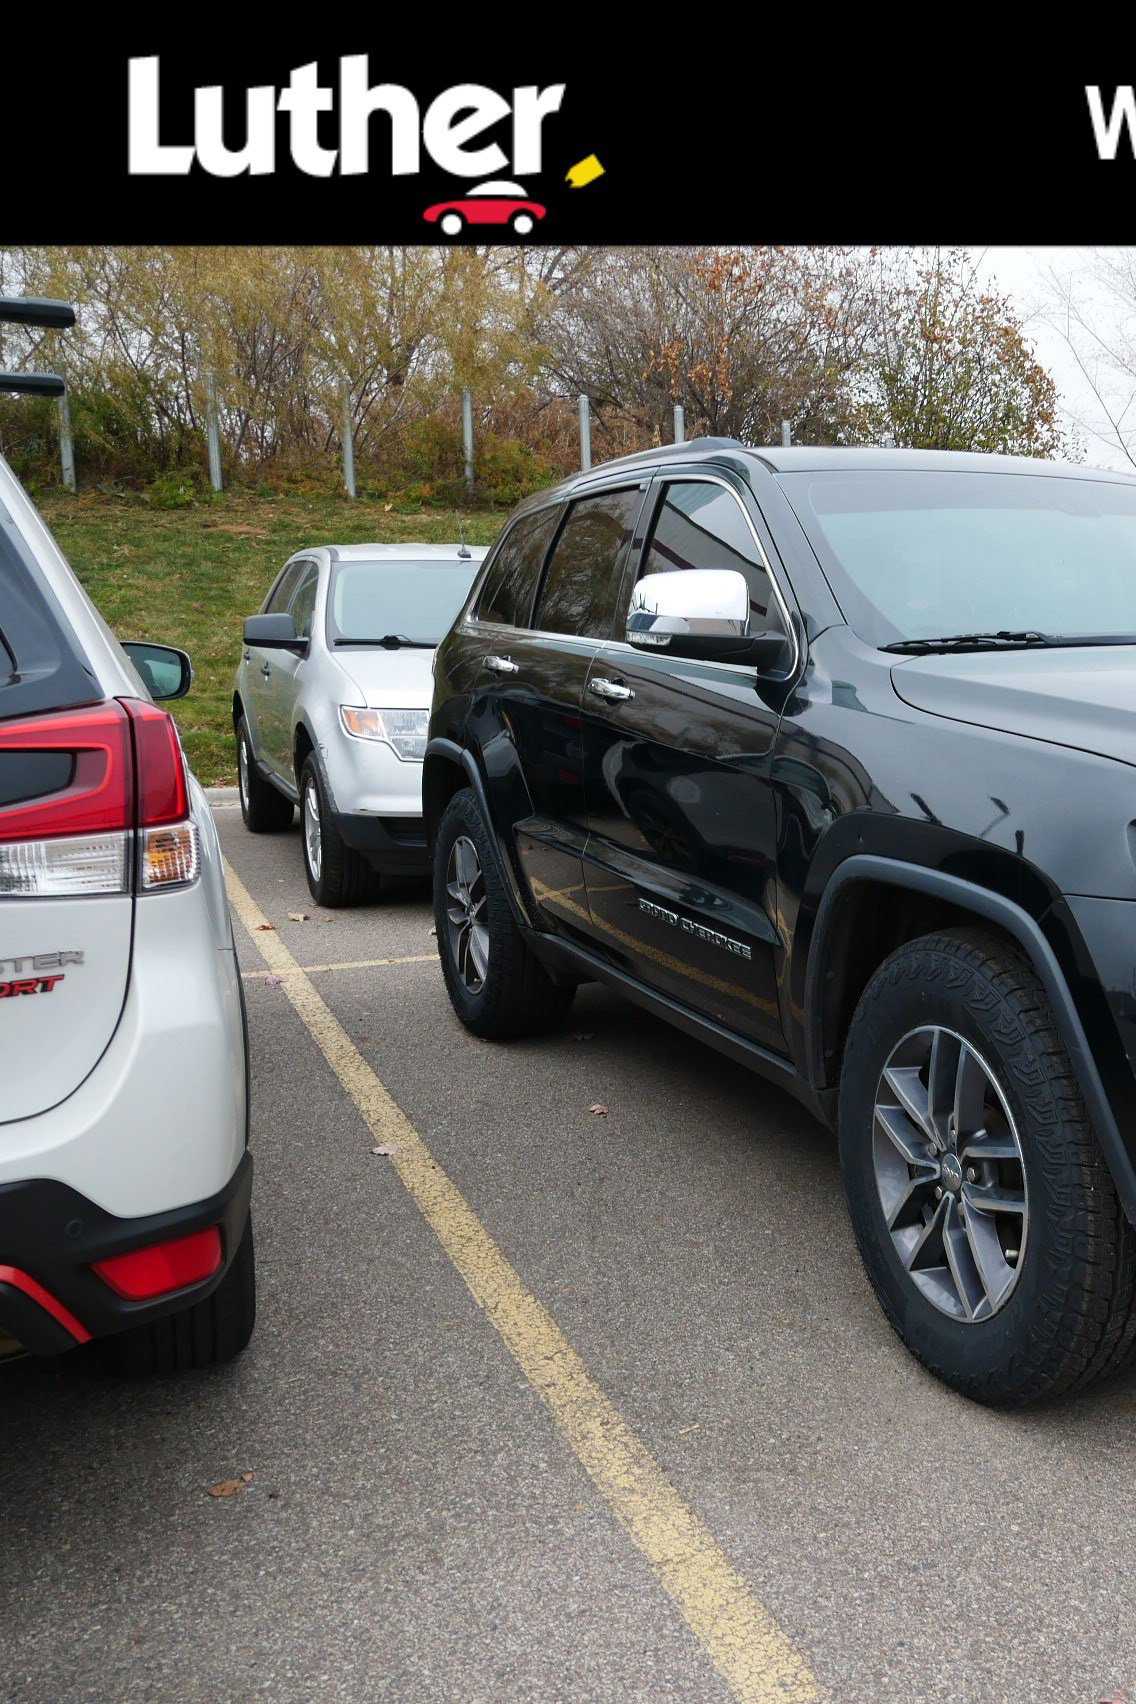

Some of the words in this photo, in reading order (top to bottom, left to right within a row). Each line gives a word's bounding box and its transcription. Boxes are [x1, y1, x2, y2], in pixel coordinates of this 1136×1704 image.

[639, 898, 679, 926] GRAND
[680, 918, 752, 960] CHEROKEE
[0, 951, 85, 975] TER
